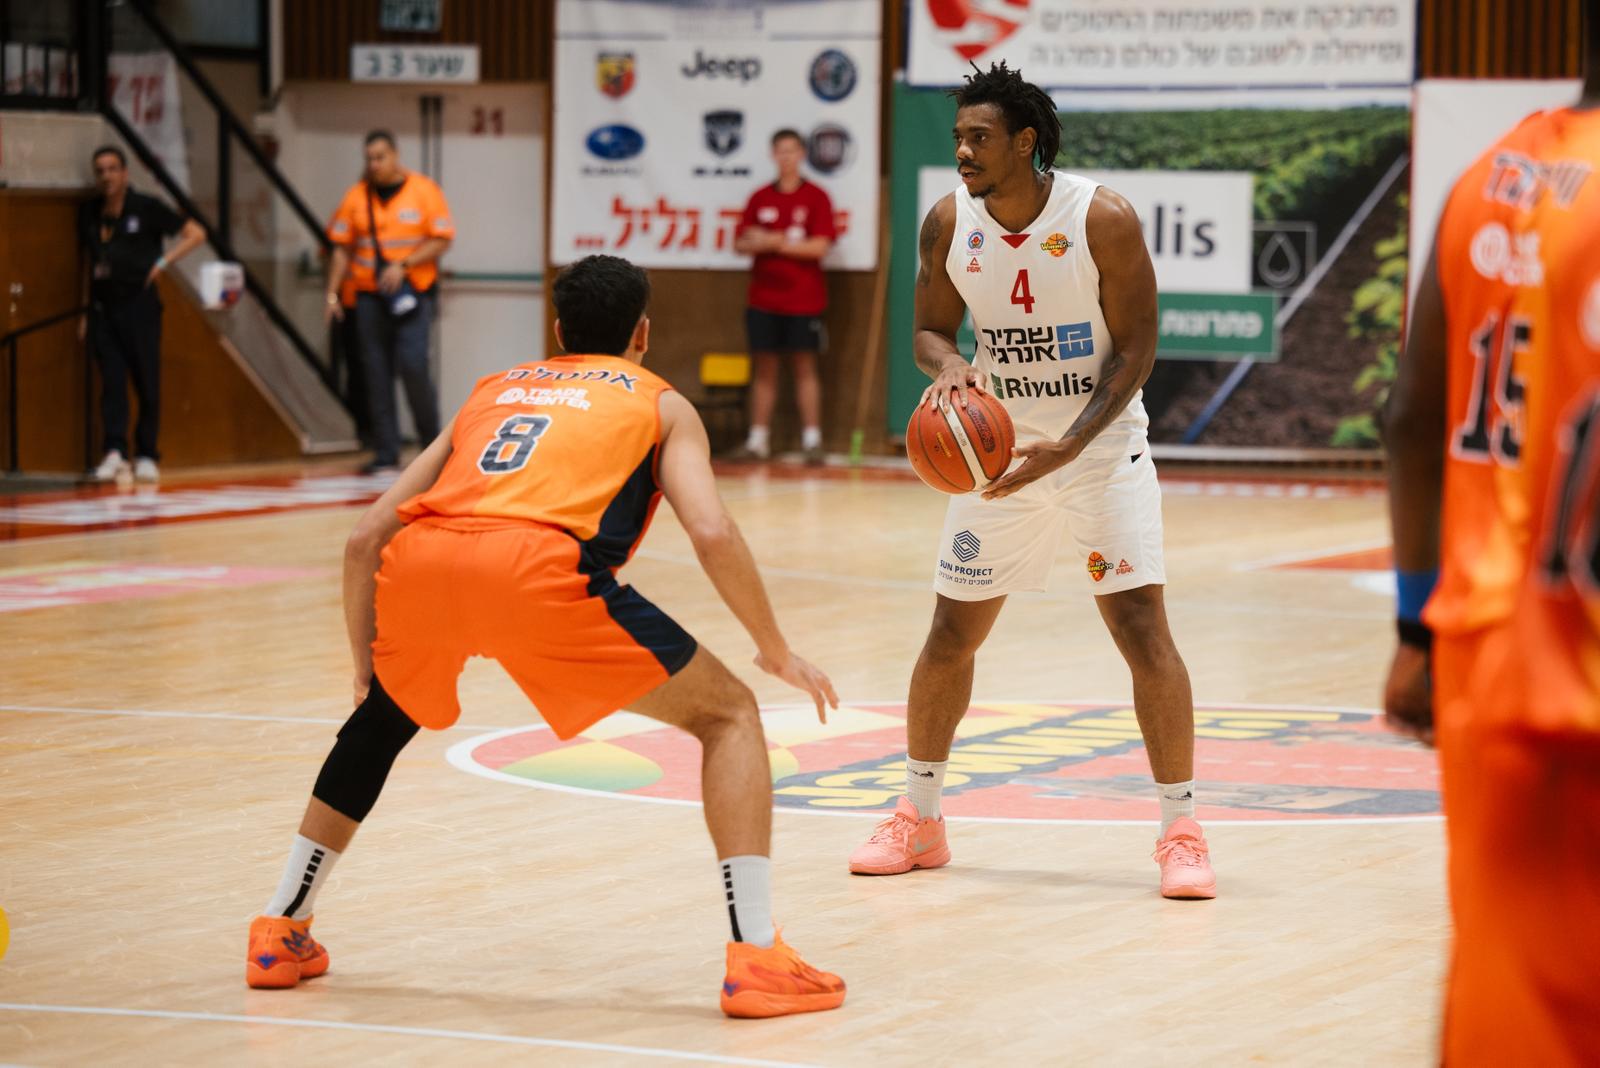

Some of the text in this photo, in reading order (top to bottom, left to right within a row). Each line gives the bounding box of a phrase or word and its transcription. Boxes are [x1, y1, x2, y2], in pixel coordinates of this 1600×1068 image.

[682, 51, 762, 82] Jeep
[1010, 268, 1036, 315] 4
[981, 326, 1055, 346] שמיר
[527, 388, 588, 399] TRADE
[1004, 373, 1094, 398] Rivulis
[521, 396, 592, 411] CENTER
[476, 413, 553, 476] 8
[940, 560, 993, 578] SUN PROJECT
